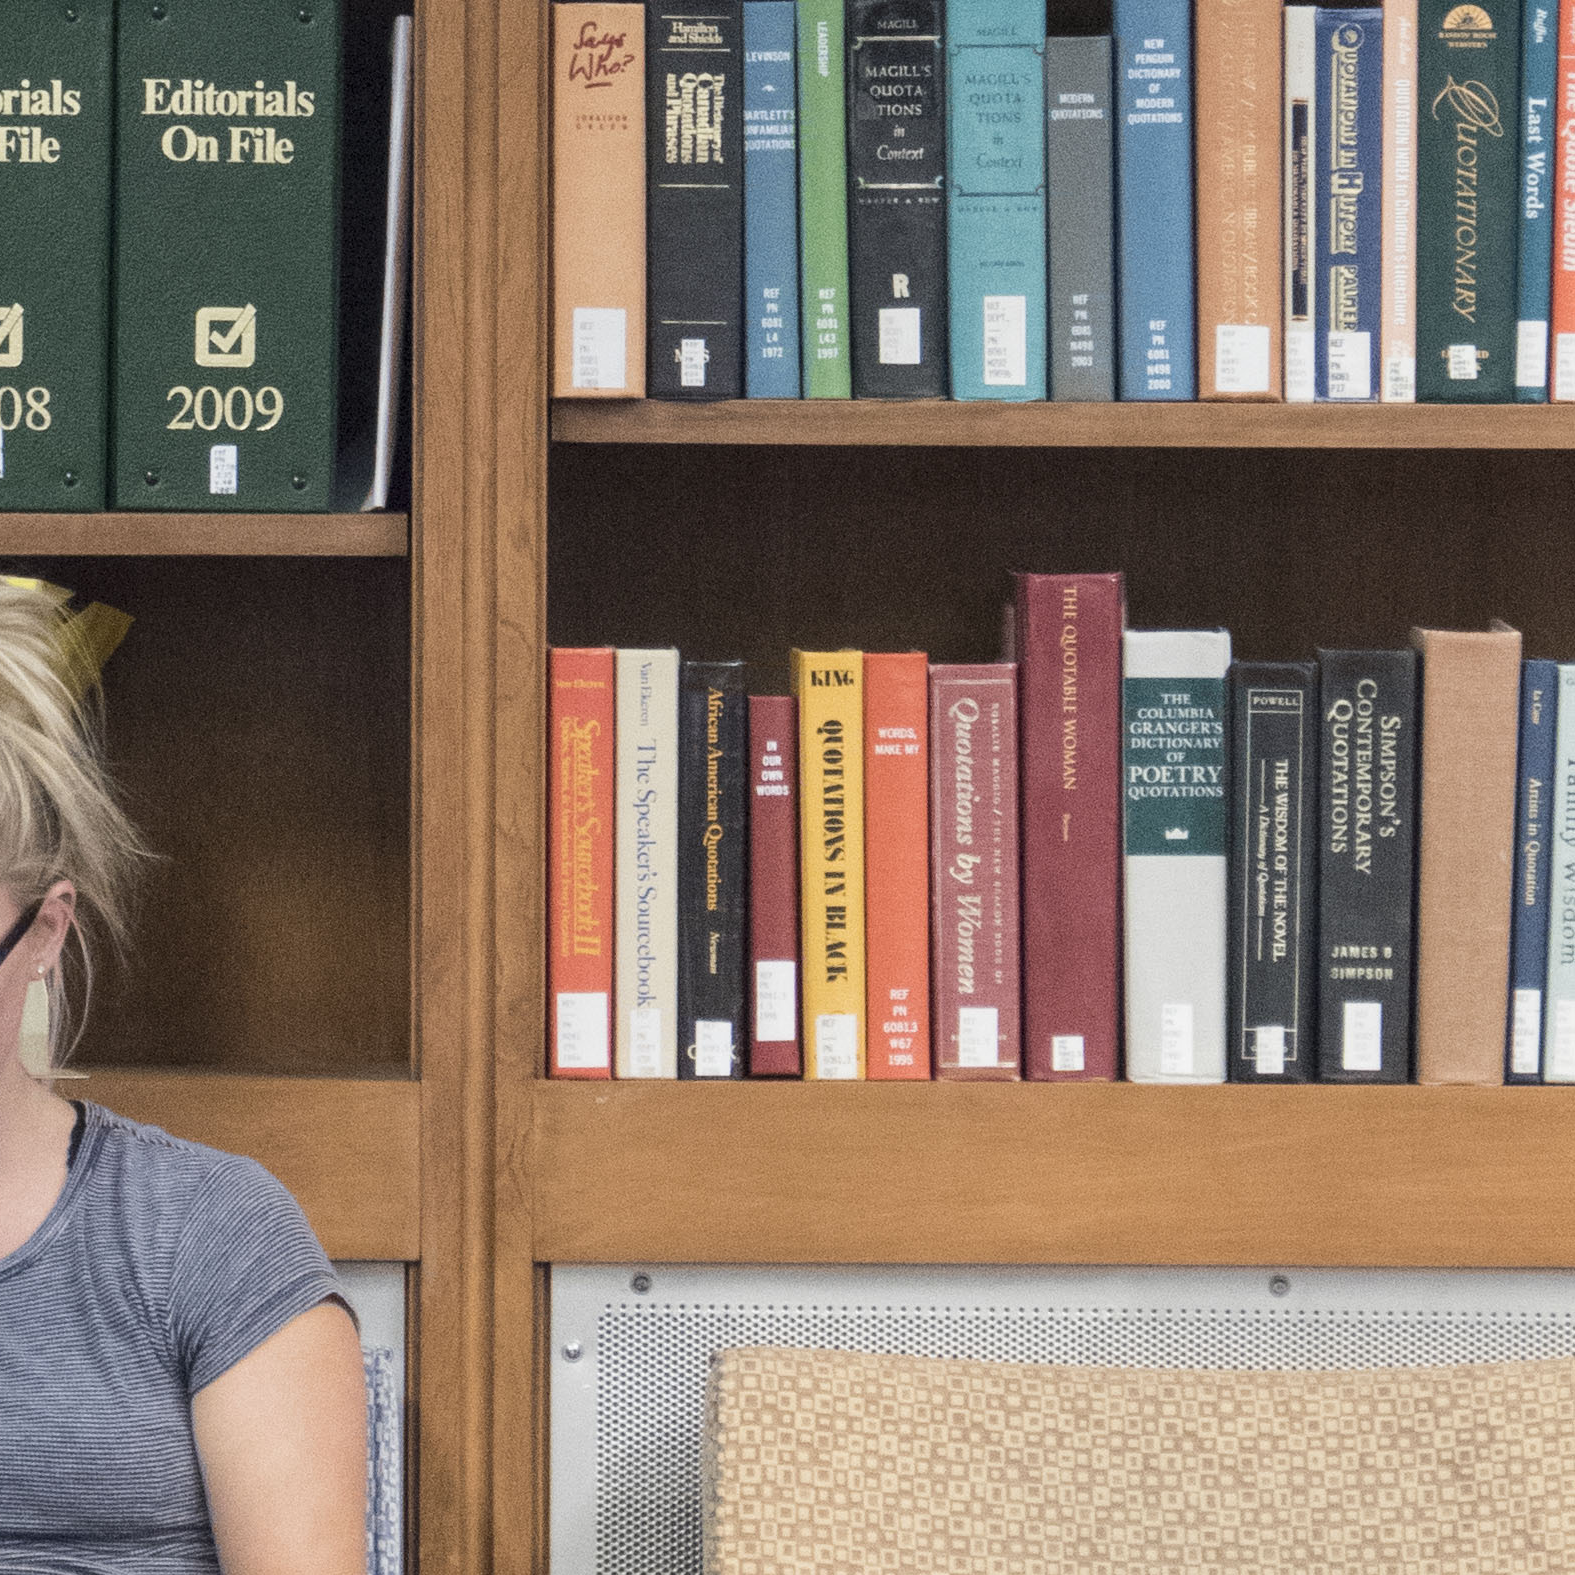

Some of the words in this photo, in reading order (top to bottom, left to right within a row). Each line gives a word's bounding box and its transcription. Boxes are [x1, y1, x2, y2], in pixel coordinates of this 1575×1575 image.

[672, 22, 718, 33] Hamilton
[877, 19, 918, 29] MAGILL
[574, 21, 626, 61] Says
[668, 34, 686, 44] and
[687, 34, 723, 44] Shields
[817, 21, 828, 77] LEADERSHIP
[1144, 39, 1164, 50] NEW
[569, 53, 635, 81] Who?
[746, 51, 790, 63] LEVINSON
[1135, 53, 1174, 65] PENGUIN
[864, 65, 932, 78] MAGILL'S
[965, 73, 1033, 85] MAGILL'S
[1128, 68, 1181, 79] DICTIONARY
[666, 74, 678, 97] and
[1149, 83, 1161, 93] OF
[1331, 23, 1364, 148] QUOTATIONS
[142, 78, 314, 117] Editorials
[1059, 93, 1095, 104] MODERN
[1136, 99, 1174, 109] MODERN
[679, 72, 698, 164] Quotations
[696, 72, 715, 163] Canadian
[877, 104, 923, 116] TIONS
[977, 112, 1021, 124] TIONS
[1051, 109, 1104, 120] QUOTATIONS
[1128, 113, 1183, 124] QUOTATIONS
[1395, 80, 1410, 144] QUOTATION
[1528, 98, 1546, 143] Last
[666, 98, 682, 164] Phrases
[893, 125, 905, 138] in
[161, 125, 219, 163] On
[229, 125, 294, 164] File
[876, 145, 924, 161] Context
[976, 154, 1022, 170] Context
[1395, 147, 1410, 184] INDEX
[1395, 186, 1409, 196] to
[1524, 152, 1546, 219] Words
[1432, 75, 1503, 322] QUOTATIONARY
[1330, 172, 1363, 255] HISTORY
[892, 273, 910, 299] R
[1329, 265, 1358, 331] PALMER
[166, 386, 284, 431] 2009
[1063, 586, 1077, 619] THE
[640, 662, 651, 683] Van
[811, 670, 855, 686] KING
[1060, 626, 1077, 712] QUOTABLE
[640, 685, 651, 726] Ekeren
[1160, 693, 1191, 705] THE
[1253, 696, 1299, 706] POWELL
[706, 687, 724, 743] African
[1138, 708, 1214, 719] COLUMBIA
[878, 728, 918, 740] WORDS,
[1130, 722, 1223, 734] GRANGER'S
[766, 741, 777, 751] IN
[875, 744, 902, 755] MAKE
[905, 744, 920, 755] MY
[1062, 718, 1077, 790] WOMAN
[1131, 737, 1221, 749] DICTIONARY
[570, 717, 601, 812] Speaker's
[636, 739, 656, 782] The
[762, 756, 782, 766] OUR
[1166, 752, 1186, 762] OF
[761, 771, 783, 781] OWN
[948, 698, 980, 845] Quotations
[1129, 765, 1222, 783] POETRY
[1274, 759, 1288, 789] THE
[1327, 699, 1353, 854] QUOTATIONS
[1355, 678, 1377, 874] CONTEMPORARY
[1379, 715, 1400, 838] SIMPSON'S
[706, 748, 723, 822] American
[756, 785, 789, 796] WORDS
[817, 719, 845, 862] QUOTATIONS
[1128, 786, 1223, 799] QUOTATIONS
[1529, 778, 1543, 818] Artists
[1274, 793, 1288, 851] WISDOM
[1528, 823, 1539, 836] in
[634, 788, 657, 882] Speaker's
[573, 816, 601, 931] Sourcebook
[702, 824, 723, 911] Quotations
[949, 855, 981, 885] by
[1274, 855, 1287, 876] OF
[1525, 840, 1541, 906] Quotation
[825, 872, 845, 896] IN
[1274, 878, 1287, 908] THE
[573, 935, 601, 956] II
[637, 885, 657, 1007] Sourcebook
[825, 906, 848, 982] BLACK
[957, 895, 982, 995] Women
[1273, 911, 1287, 962] NOVEL
[1331, 946, 1378, 958] JAMES
[1383, 946, 1392, 958] B
[1330, 968, 1393, 980] SIMPSON
[890, 989, 909, 1000] REF
[893, 1006, 907, 1016] PN
[883, 1022, 918, 1033] 6081.3
[890, 1038, 911, 1049] W67
[888, 1055, 914, 1066] 1996
